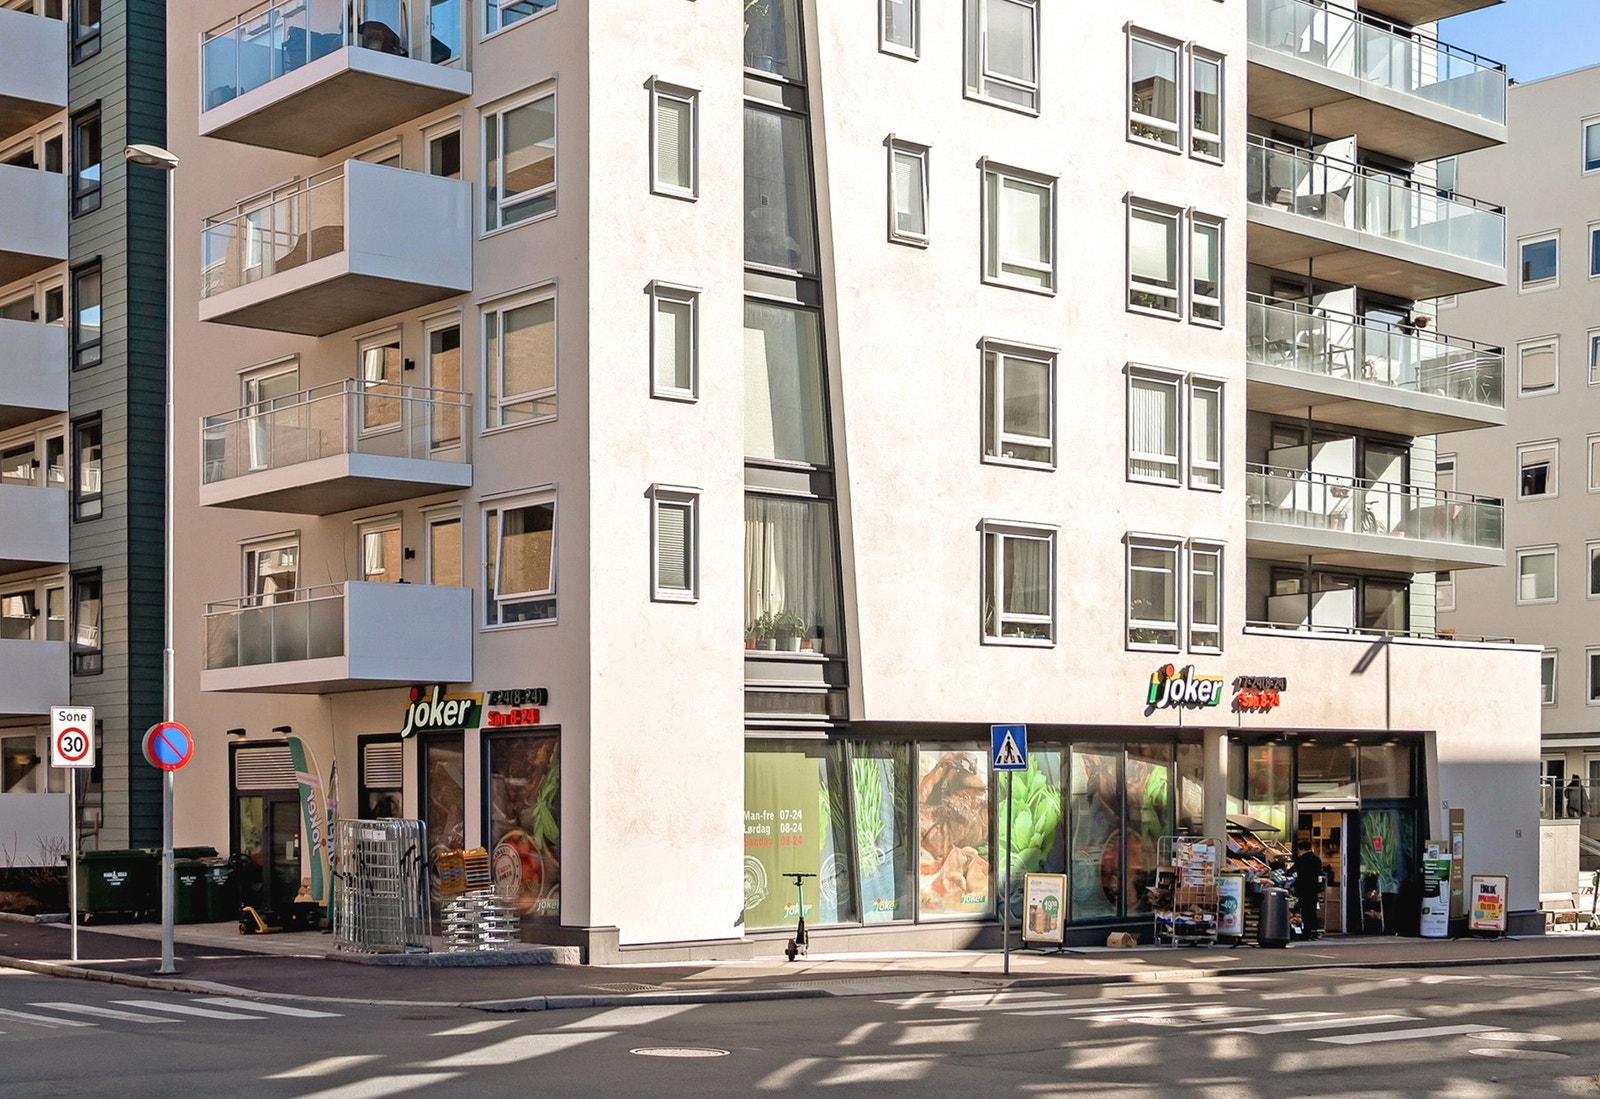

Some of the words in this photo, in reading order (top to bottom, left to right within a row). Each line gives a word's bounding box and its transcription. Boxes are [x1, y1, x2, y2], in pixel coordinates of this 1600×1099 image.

[1157, 664, 1223, 708] joker
[58, 710, 87, 722] Sone
[401, 685, 471, 738] joker
[509, 708, 537, 725] 8-24
[63, 736, 83, 752] 30
[744, 809, 774, 821] Man-fre
[779, 809, 802, 821] 07-24
[744, 823, 771, 836] Lørdag
[780, 822, 802, 833] 08-24
[780, 835, 803, 846] 08-24
